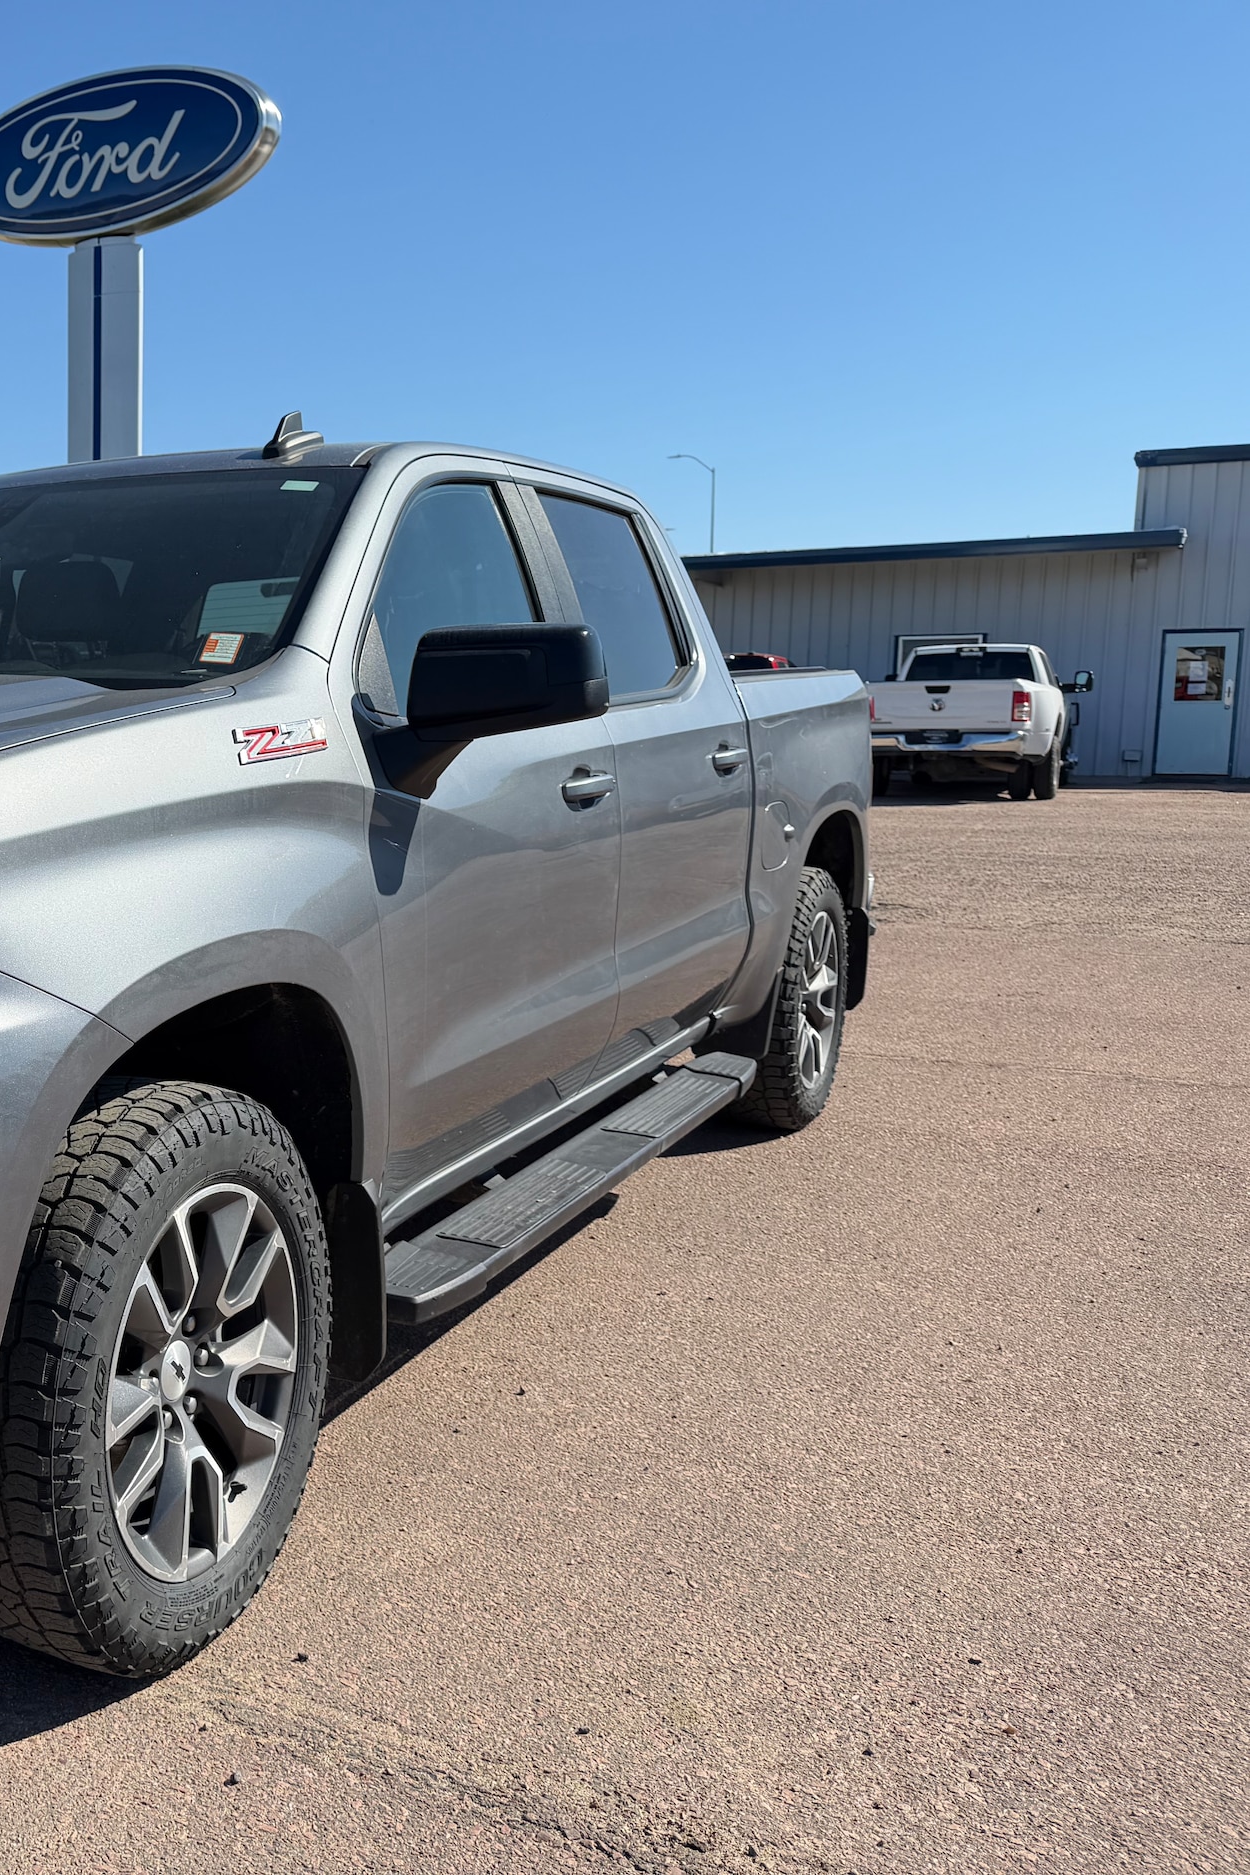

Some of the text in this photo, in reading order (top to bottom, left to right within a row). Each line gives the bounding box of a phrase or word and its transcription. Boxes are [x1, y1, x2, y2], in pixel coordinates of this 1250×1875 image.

[4, 99, 186, 210] Ford
[90, 1468, 133, 1602] TRAIL
[139, 1547, 264, 1631] COURSER
